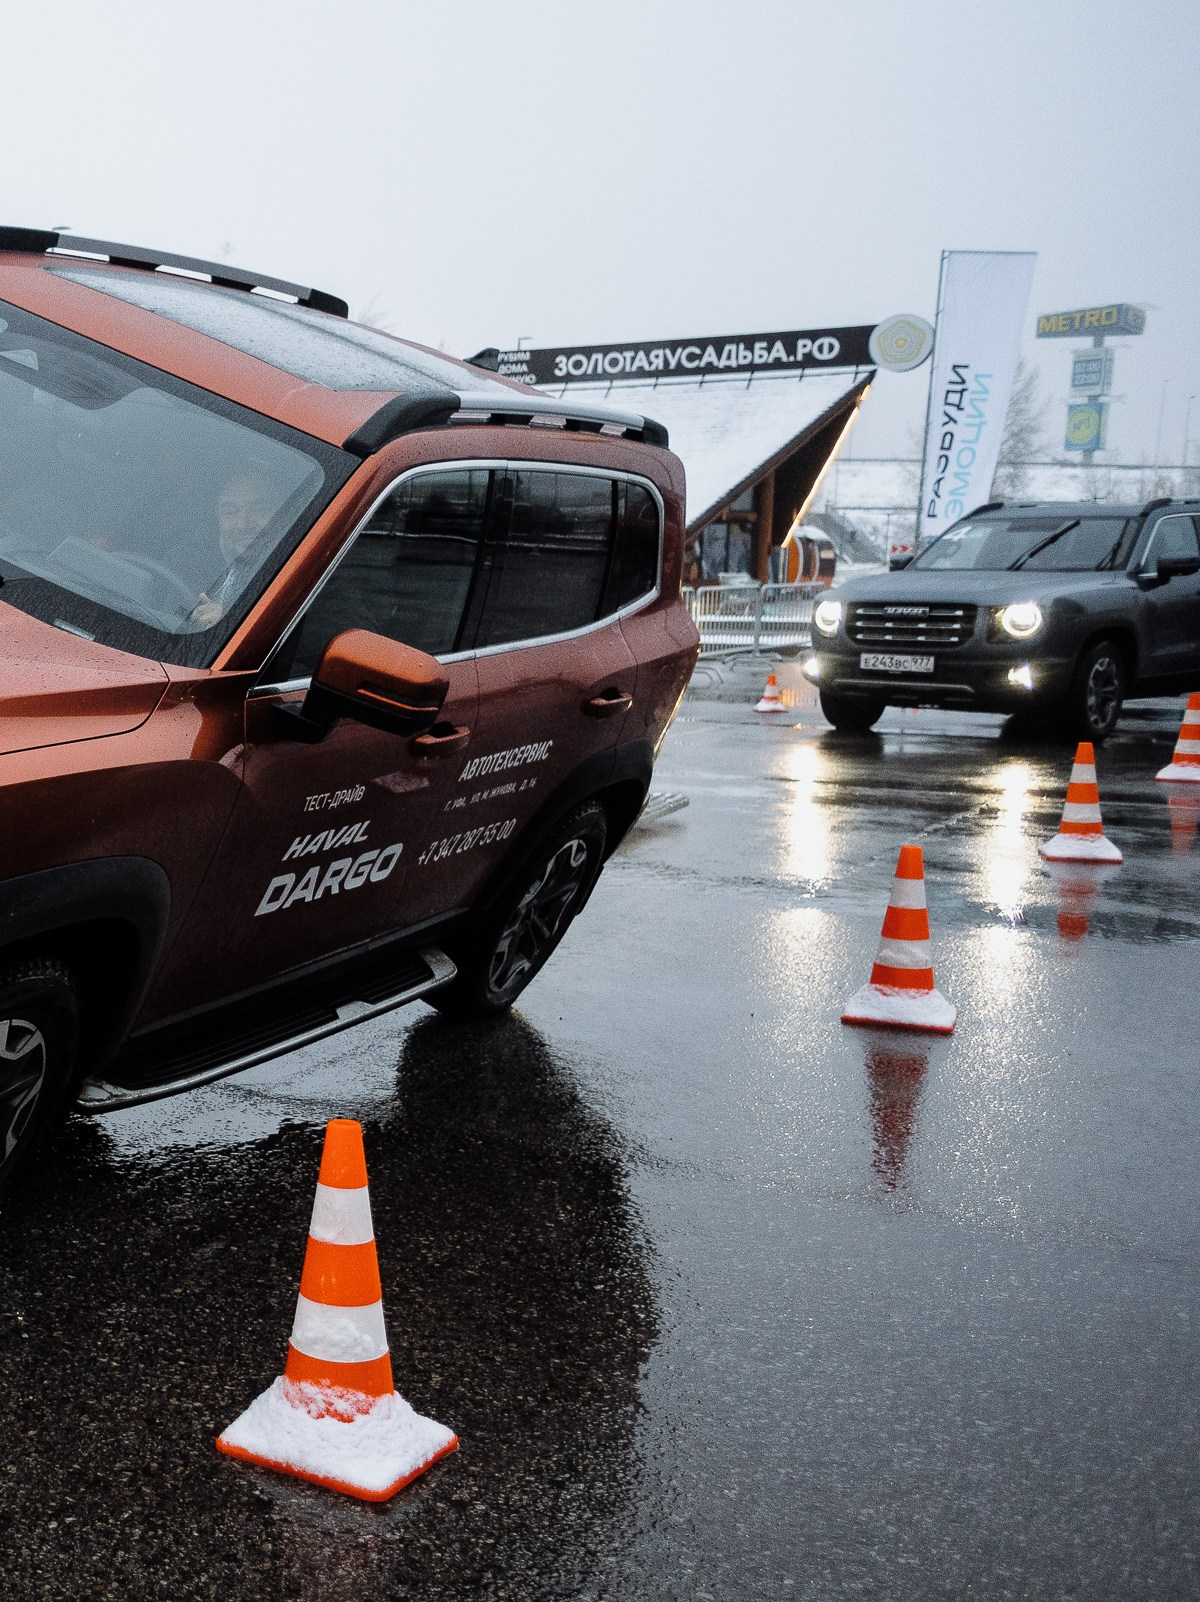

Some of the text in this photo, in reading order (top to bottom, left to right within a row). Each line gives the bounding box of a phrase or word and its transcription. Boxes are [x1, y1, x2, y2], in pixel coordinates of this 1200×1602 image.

[1038, 306, 1119, 333] METRO
[553, 336, 841, 377] ЗОЛОТАЯУСАДЬБА.РФ
[927, 364, 970, 519] РАЗБУДИ
[458, 740, 553, 782] АВТОТЕХСЕРВИС
[303, 784, 366, 812] ТЕСТ-ДРАЙВ
[281, 820, 371, 862] HAVAL
[254, 843, 404, 917] DARGO
